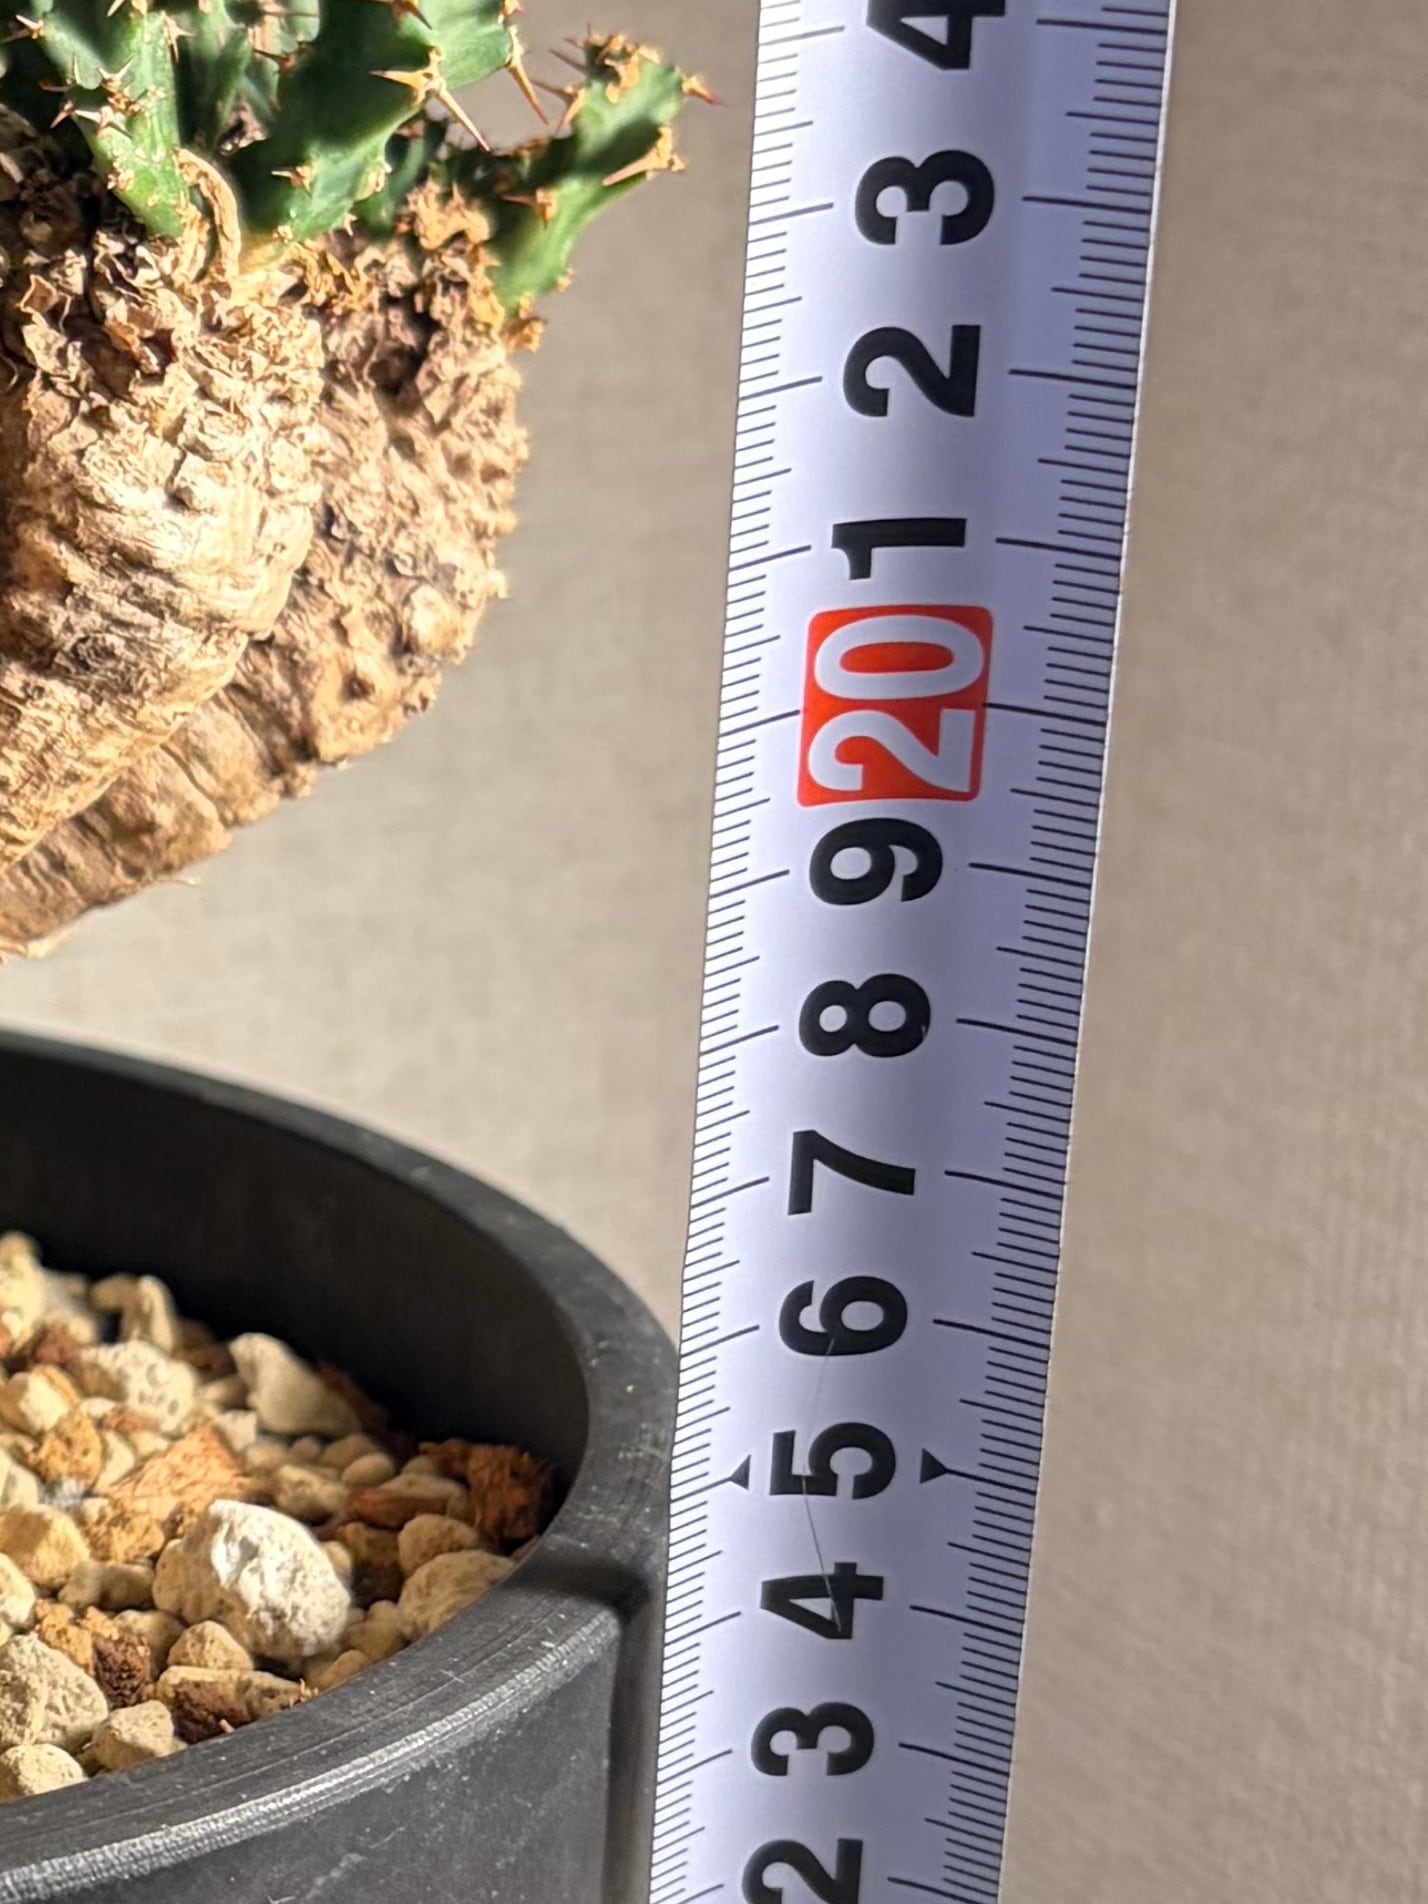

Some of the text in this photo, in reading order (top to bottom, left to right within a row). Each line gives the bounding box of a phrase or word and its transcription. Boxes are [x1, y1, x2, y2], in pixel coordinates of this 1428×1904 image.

[854, 149, 995, 246] 3
[843, 324, 981, 417] 2
[831, 517, 967, 580] 1
[807, 614, 984, 793] 20
[809, 817, 943, 906] 9
[798, 973, 931, 1058] 8
[788, 1129, 916, 1216] 7
[779, 1274, 907, 1357] 6
[769, 1421, 896, 1501] 5
[760, 1562, 884, 1640] 4
[750, 1702, 875, 1777] 3
